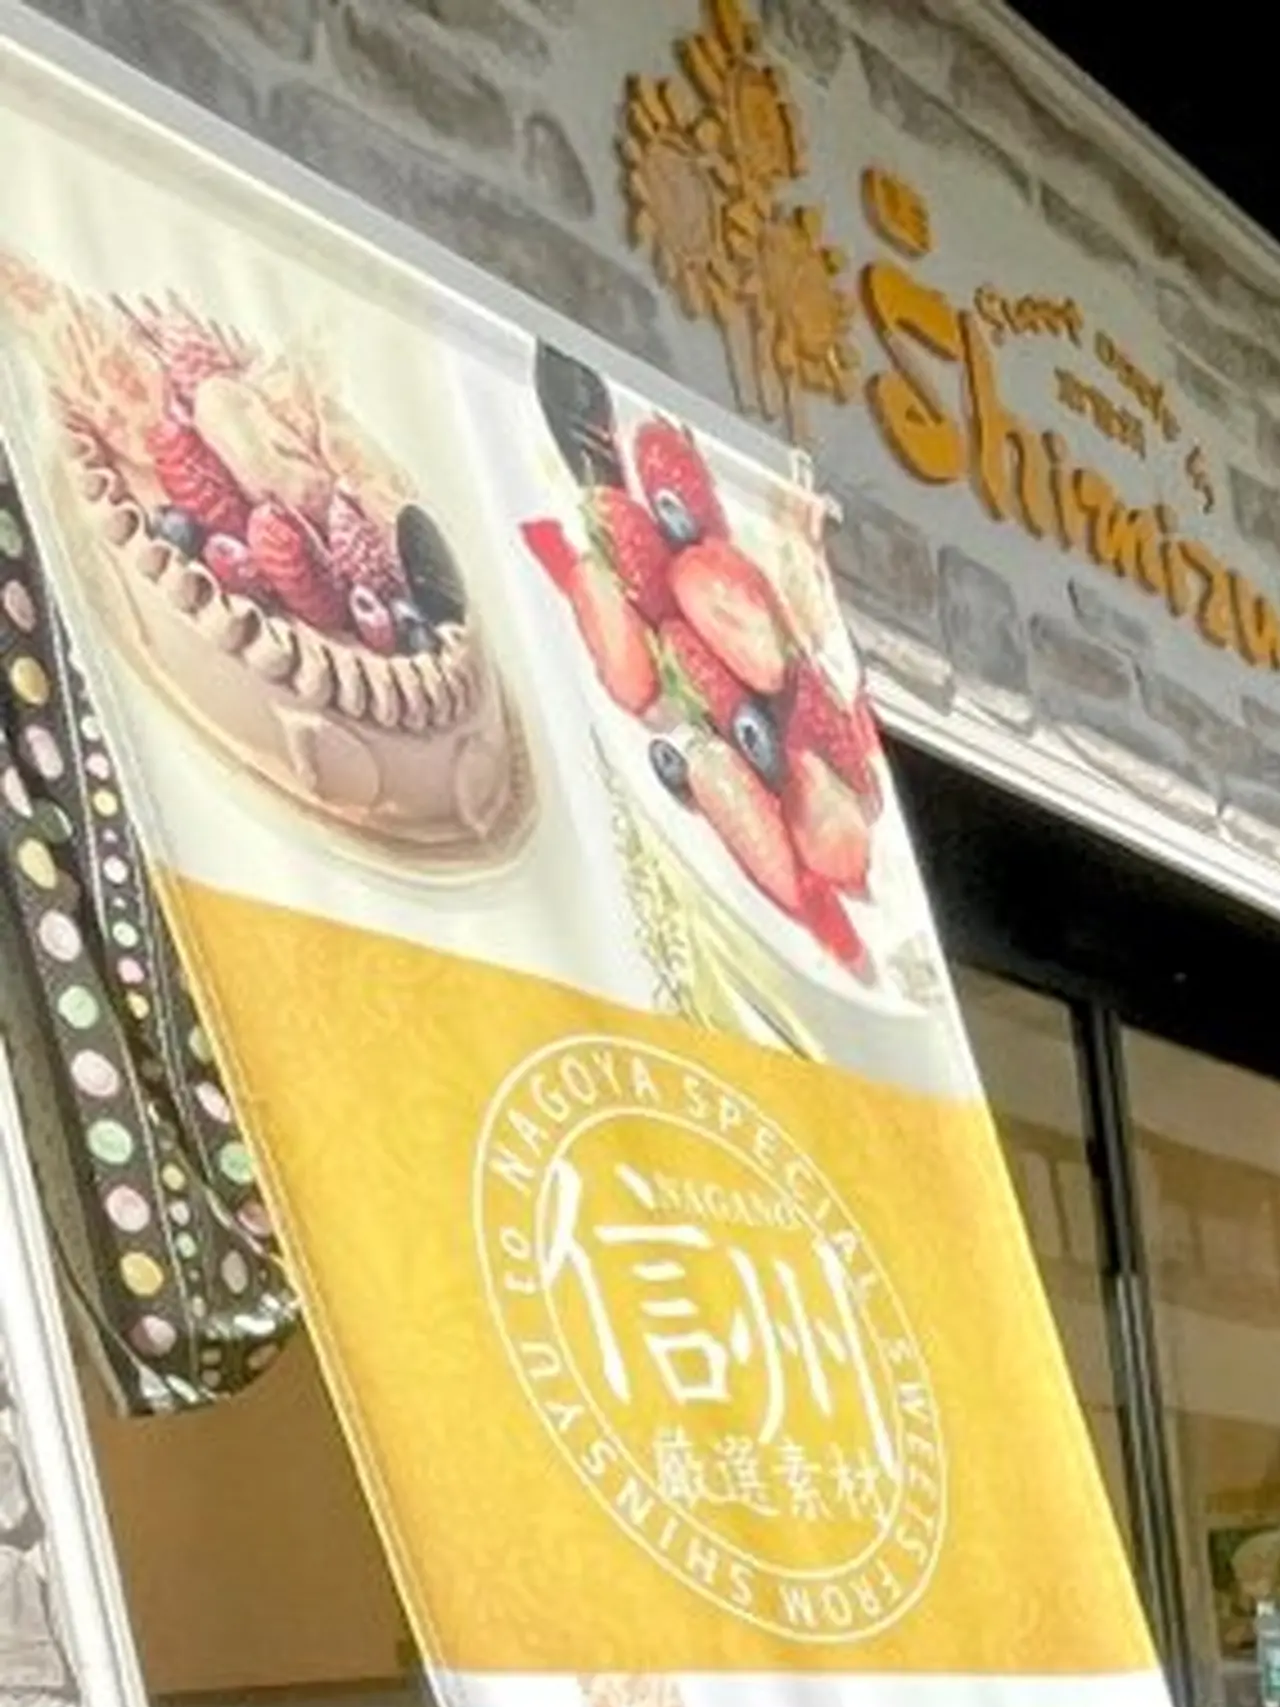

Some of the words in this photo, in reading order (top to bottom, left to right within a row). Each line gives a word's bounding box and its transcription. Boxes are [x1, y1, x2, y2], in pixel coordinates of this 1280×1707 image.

[492, 1050, 656, 1196] NAGOYA
[681, 1073, 870, 1313] SPECIAL
[537, 1157, 906, 1482] 信州
[519, 1343, 760, 1608] SHINSYU
[778, 1560, 903, 1630] FROM
